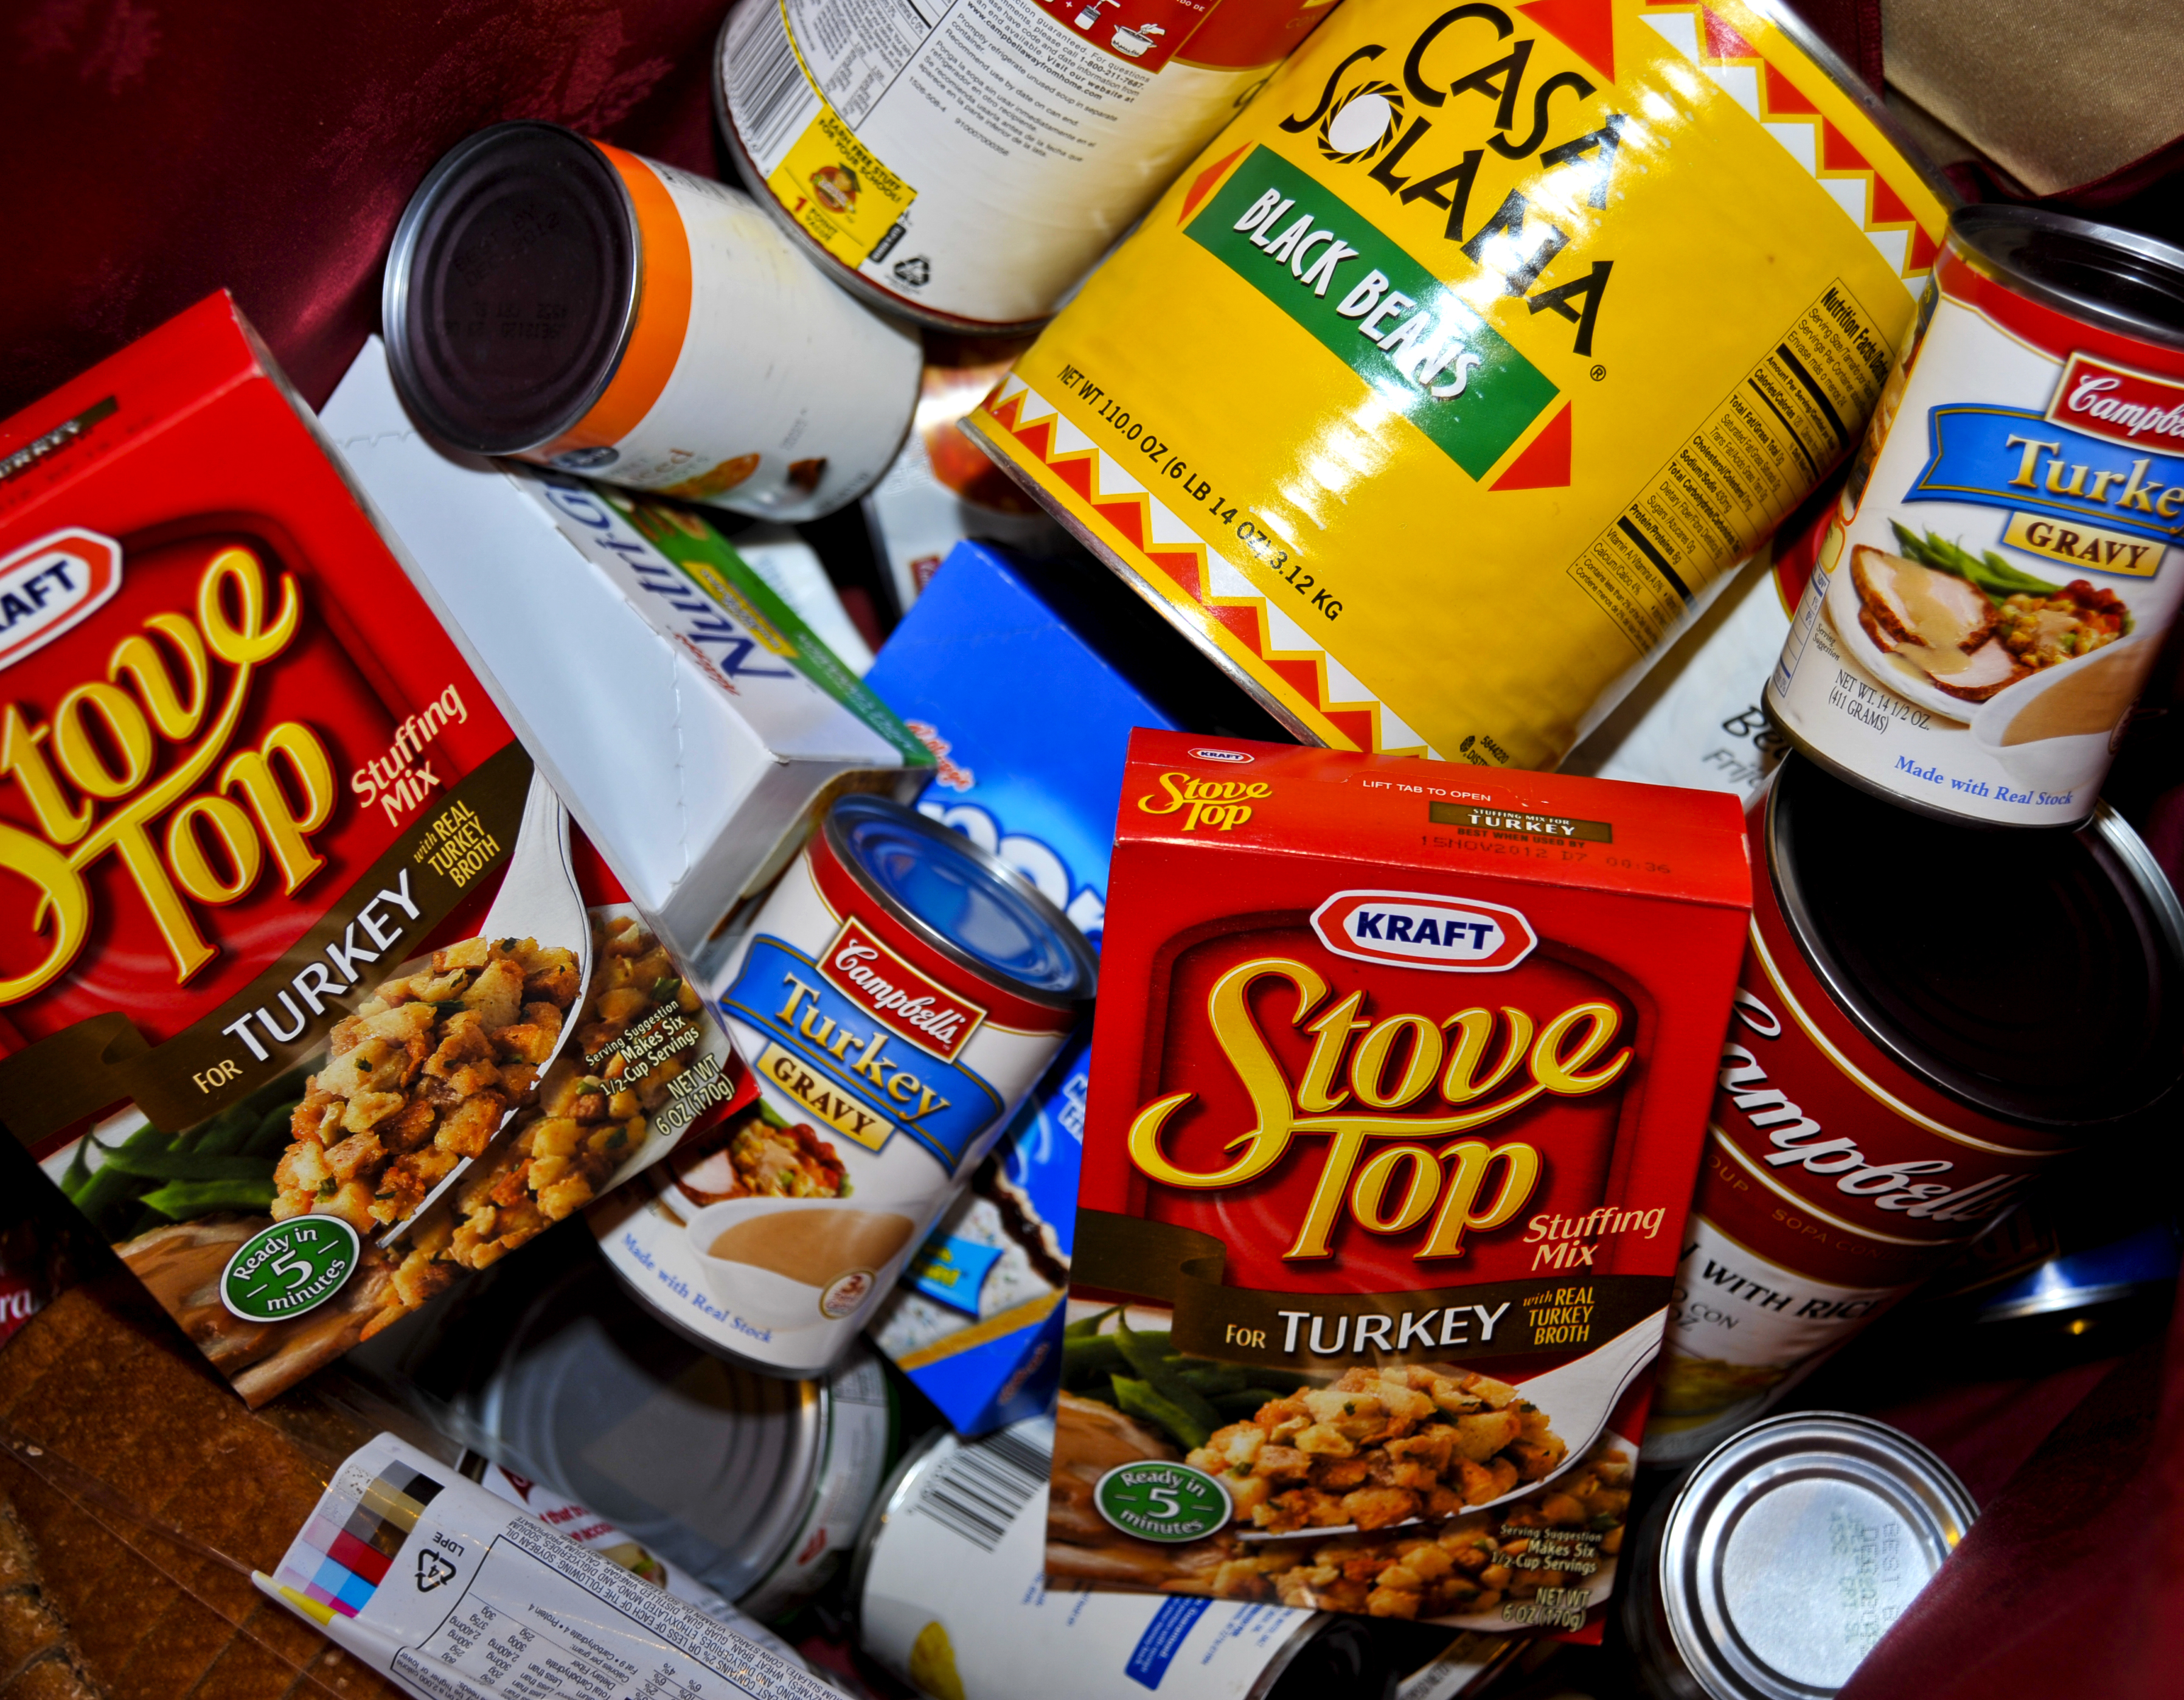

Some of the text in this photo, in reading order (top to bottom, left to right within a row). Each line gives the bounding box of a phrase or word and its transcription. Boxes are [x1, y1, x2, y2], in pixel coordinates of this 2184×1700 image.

[951, 21, 986, 54] container.
[958, 13, 988, 46] Promptly
[1034, 24, 1060, 46] please
[1062, 43, 1079, 59] call
[1037, 16, 1150, 82] guaranteed. For questions
[1004, 25, 1122, 100] available. Visit website
[1403, 3, 1629, 211] CASA
[819, 119, 835, 141] FOR
[835, 139, 859, 166] YOUR
[859, 166, 903, 204] SCHOOL!
[828, 118, 902, 192] EARN FREE STUFF
[1279, 44, 1615, 358] SOLANA
[1233, 187, 1358, 299] BLACK
[1804, 307, 1834, 340] Serving
[1818, 287, 1863, 338] Nutrition
[1337, 269, 1480, 401] BEANS
[1786, 331, 1812, 361] Envase
[1795, 319, 1857, 393] Servings Per Container
[1678, 448, 1734, 513] Sodium/Sodio 430mg
[1690, 434, 1747, 499] Cholesterol/Colesterol
[2006, 434, 2184, 535] Turke
[1057, 364, 1344, 622] NET WT 110.0 OZ (6 LB 14 OZ) 3.12 KG
[1669, 550, 1684, 564] 8g
[2025, 521, 2149, 569] GRAVY
[1812, 633, 1840, 662] Suggestion
[1816, 623, 1836, 648] Serving
[1828, 685, 1890, 734] (411 GRAMS)
[1835, 669, 1930, 731] NET WT. 14 1/2 OZ.
[351, 684, 468, 808] Stuffing
[1200, 750, 1242, 761] KRAFT
[1480, 735, 1511, 765] 5844220
[380, 761, 441, 827] Mix
[1138, 772, 1273, 814] Stove
[1362, 779, 1491, 802] LIFT TAB TO OPEN
[1894, 755, 2074, 807] Made with Real Stock
[414, 800, 475, 864] with REAL
[1181, 800, 1252, 831] Top
[1467, 813, 1576, 836] TURKEY
[1473, 808, 1570, 826] STUFFING MIX FOR
[114, 721, 335, 985] Top
[428, 816, 485, 876] TURKEY
[1457, 827, 1586, 849] BEST WHEN USED BY
[448, 834, 501, 888] BROTH
[1355, 909, 1494, 951] KRAFT
[192, 867, 423, 1096] FOR TURKEY
[834, 939, 967, 1045] Campbell's
[585, 1001, 680, 1067] Serving Suggestion
[621, 1016, 687, 1064] Makes Six
[774, 972, 952, 1122] Turkey
[600, 1027, 699, 1096] 1/2-Cup Servings
[667, 1052, 721, 1100] NET WT
[1128, 957, 1635, 1188] Stove
[655, 1072, 736, 1136] 6 OZ (170g)
[772, 1056, 877, 1137] GRAVY
[1282, 1118, 1543, 1262] Top
[1523, 1204, 1666, 1245] Stuffing
[1772, 1209, 1827, 1243] SOPA
[232, 1227, 318, 1280] Ready in
[271, 1249, 313, 1289] 5
[1531, 1243, 1598, 1272] Mix
[267, 1259, 346, 1311] minutes
[621, 1233, 773, 1345] Made with Real Stock
[1522, 1285, 1595, 1308] with REAL
[1702, 1259, 1792, 1312] WITH
[1225, 1302, 1512, 1356] FOR TURKEY
[1529, 1304, 1595, 1327] TURKEY
[1533, 1323, 1590, 1346] BROTH
[1120, 1469, 1206, 1497] Ready in
[1146, 1487, 1181, 1518] 5
[1120, 1510, 1204, 1535] minutes
[1500, 1524, 1603, 1542] Serving Suggestion
[433, 1531, 465, 1557] LDPE
[518, 1536, 556, 1563] SOYBEAN
[1492, 1551, 1598, 1576] 1/2-Cup Servings
[1528, 1539, 1596, 1558] Makes Six
[554, 1558, 604, 1594] FOLLOWING:
[602, 1588, 620, 1603] THE
[619, 1598, 633, 1612] OF
[632, 1606, 655, 1625] EACH
[1502, 1603, 1587, 1633] 6 OZ (170g)
[1535, 1587, 1591, 1608] NET WT
[653, 1620, 667, 1633] OF
[666, 1628, 689, 1646] LESS
[687, 1641, 702, 1655] OR
[701, 1650, 717, 1665] 2%
[715, 1659, 757, 1690] CONTAINS
